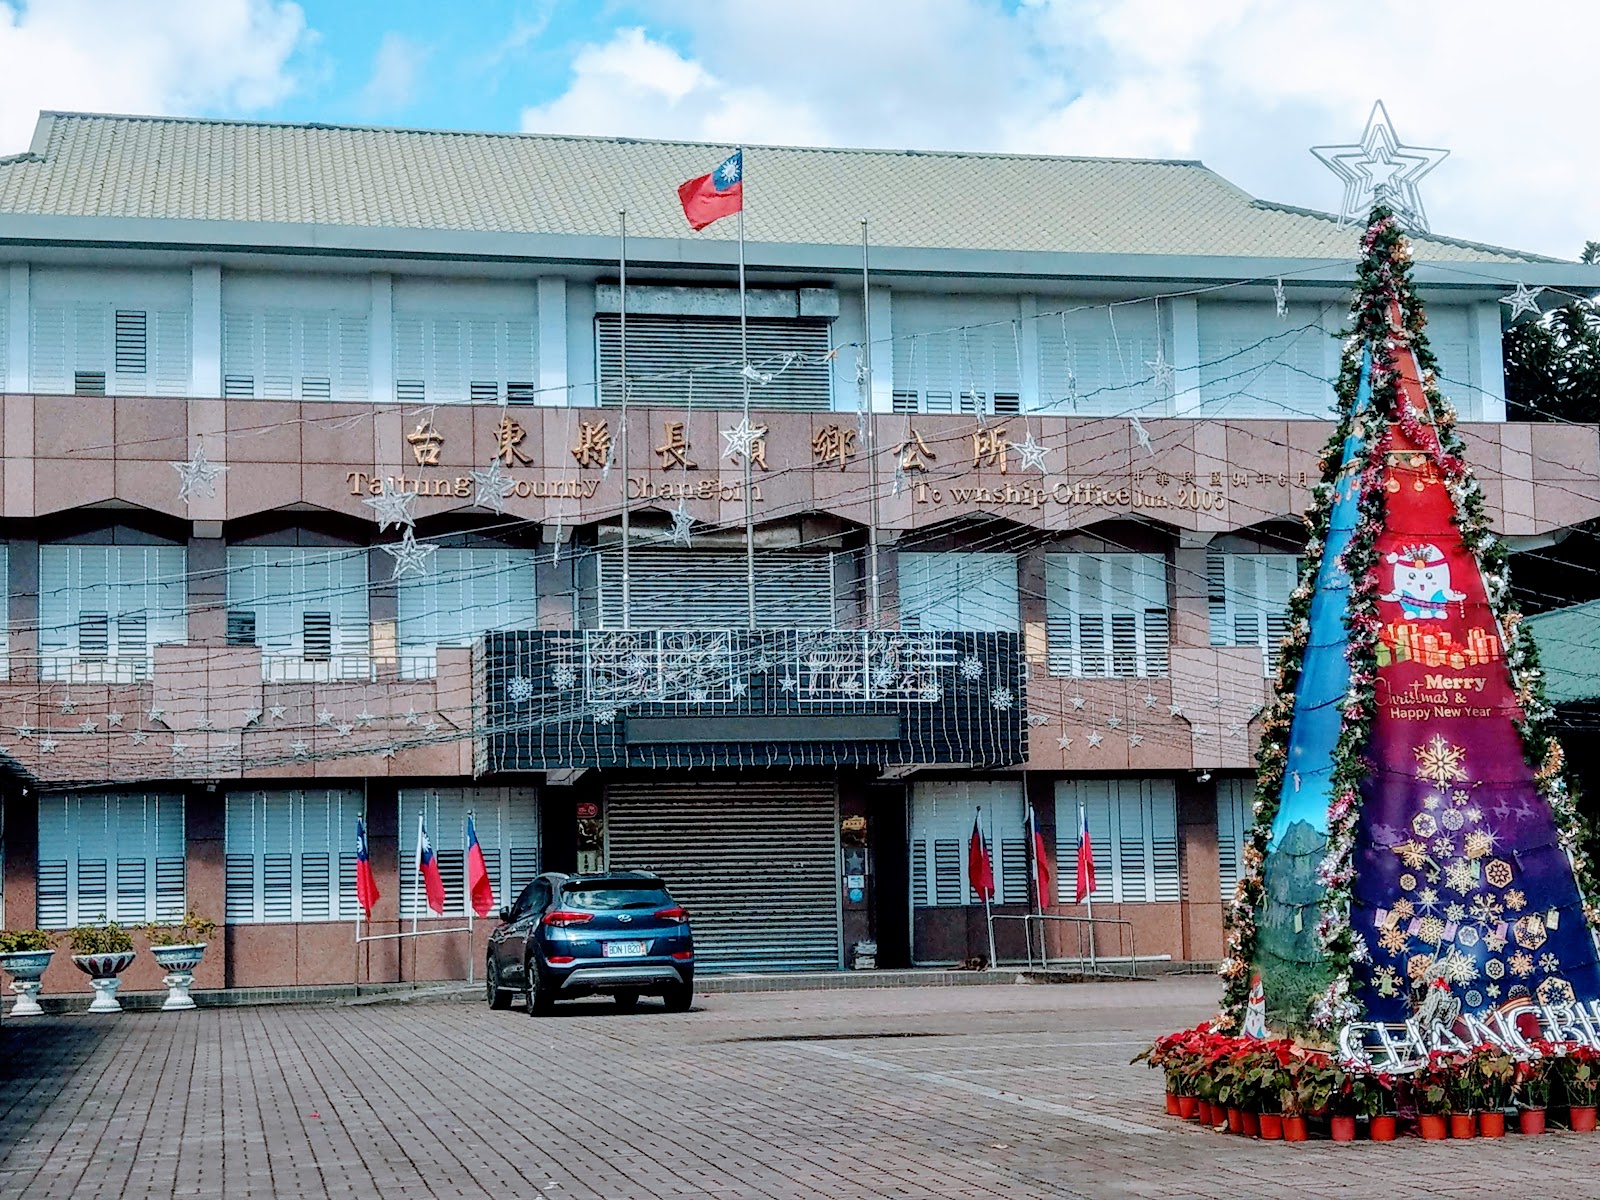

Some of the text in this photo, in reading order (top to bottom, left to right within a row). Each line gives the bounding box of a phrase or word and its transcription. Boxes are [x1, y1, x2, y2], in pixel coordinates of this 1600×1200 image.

[346, 471, 474, 498] Taitung
[1052, 482, 1131, 507] Office
[1177, 487, 1226, 511] 2005
[1424, 674, 1487, 692] Merry
[1455, 692, 1467, 704] &
[1390, 706, 1492, 721] Happy New Year
